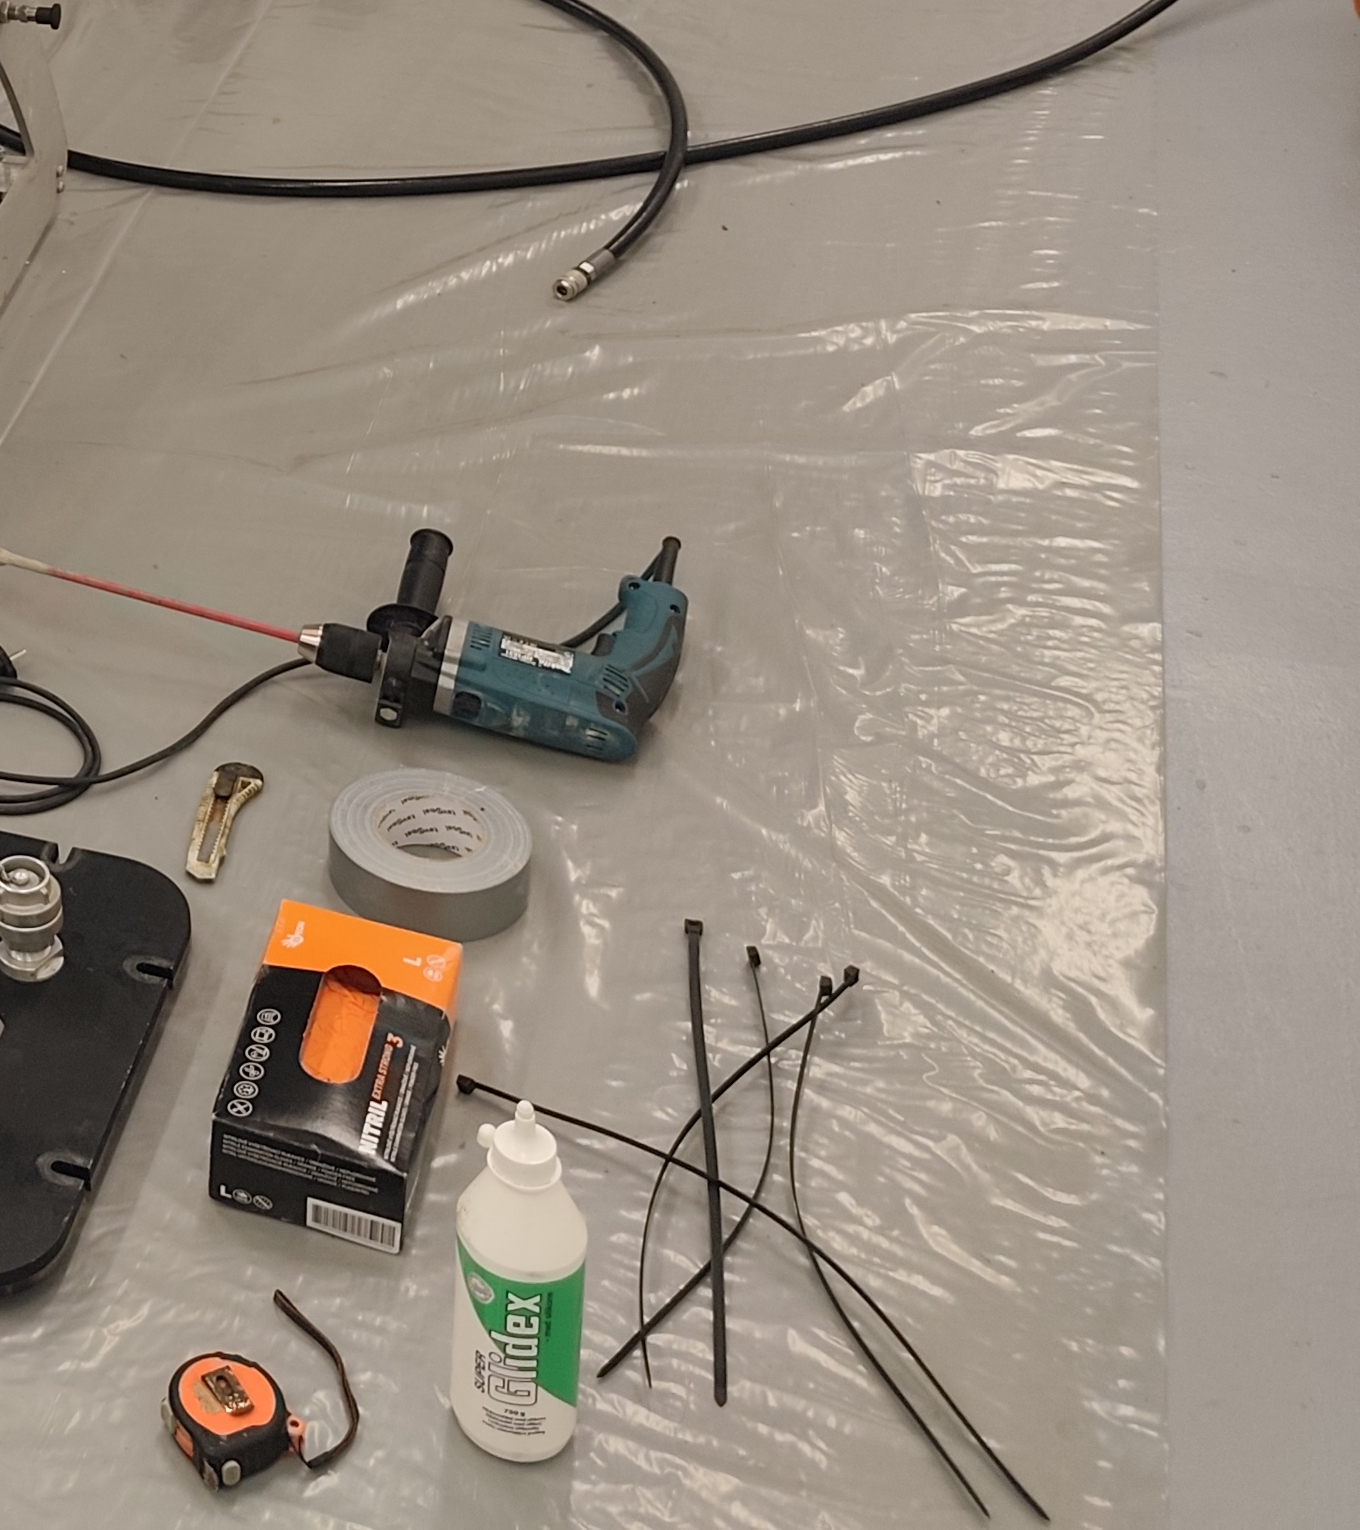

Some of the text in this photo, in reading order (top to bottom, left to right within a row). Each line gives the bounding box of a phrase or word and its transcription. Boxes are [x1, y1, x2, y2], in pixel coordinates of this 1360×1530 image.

[371, 1073, 386, 1100] EXTRA
[358, 1100, 388, 1155] NITRIL
[219, 1184, 232, 1199] L
[487, 1290, 542, 1406] Glidex
